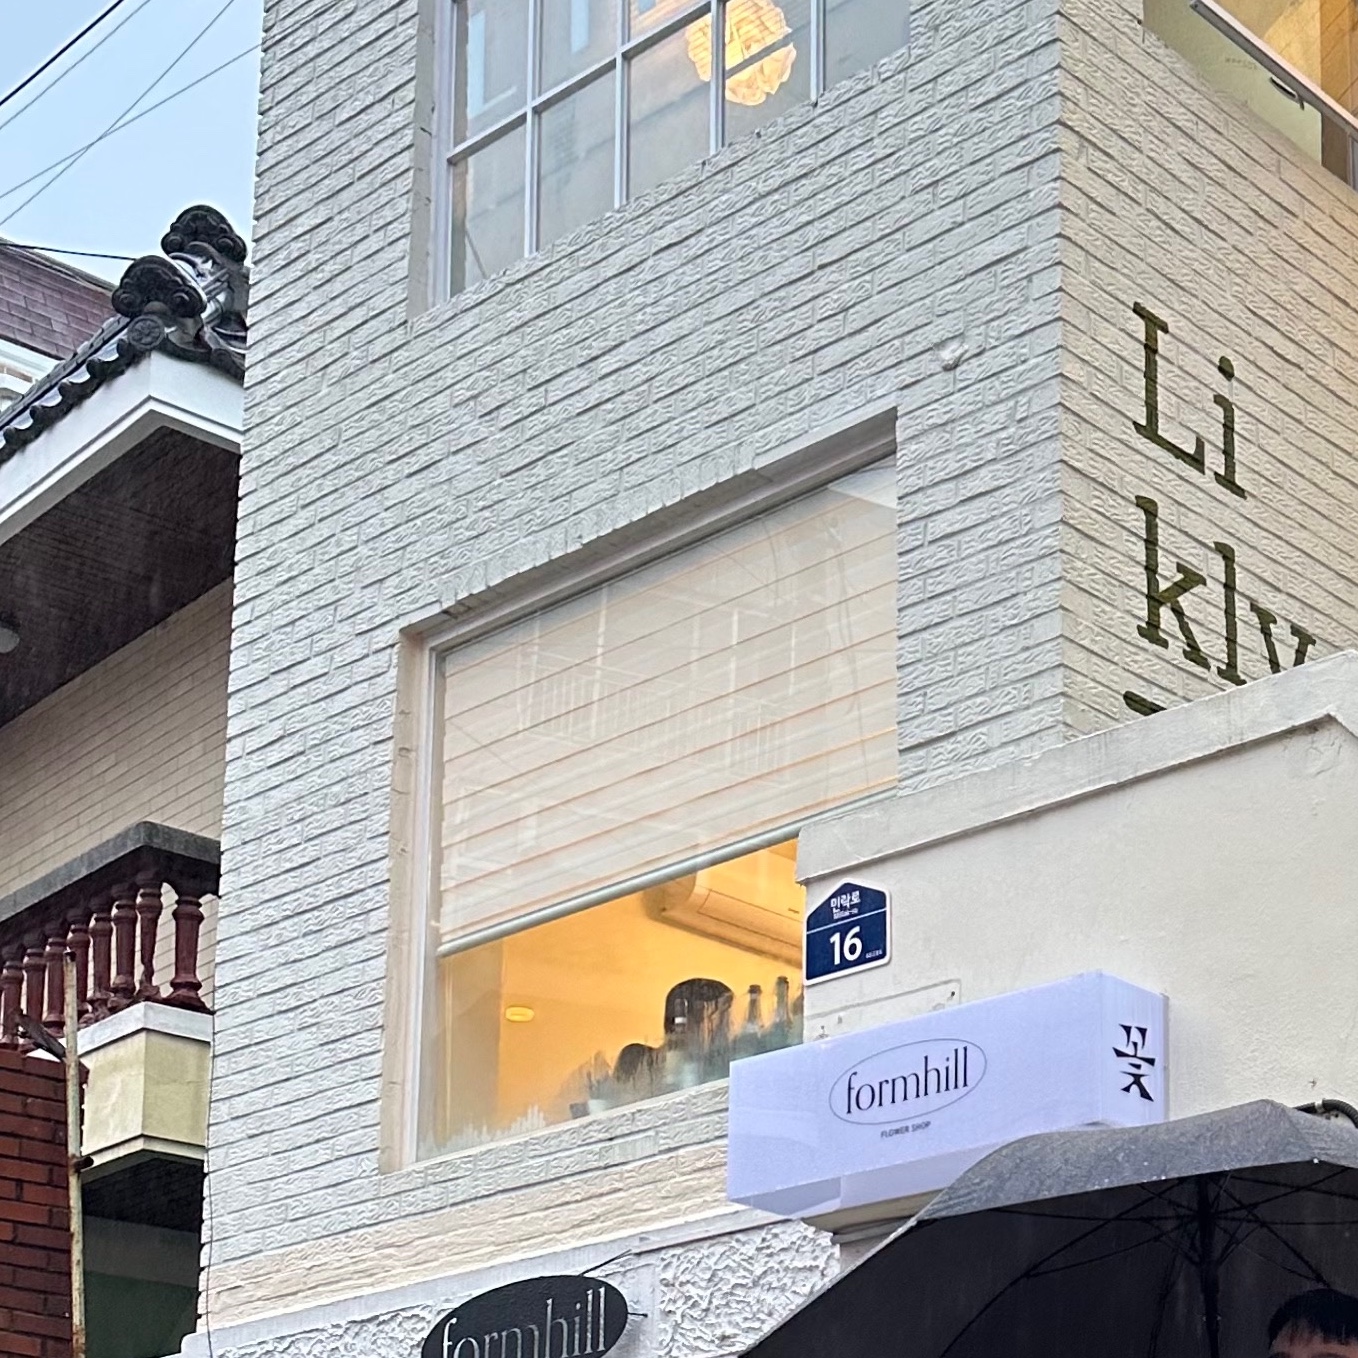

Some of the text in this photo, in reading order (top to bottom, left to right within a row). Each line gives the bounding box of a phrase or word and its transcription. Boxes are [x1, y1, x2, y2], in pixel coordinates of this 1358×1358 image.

[1132, 301, 1247, 499] Li
[829, 925, 863, 966] 16
[846, 1046, 970, 1115] formhill
[1112, 1023, 1156, 1102] 꽃
[880, 1120, 932, 1138] FLOWER SHOP
